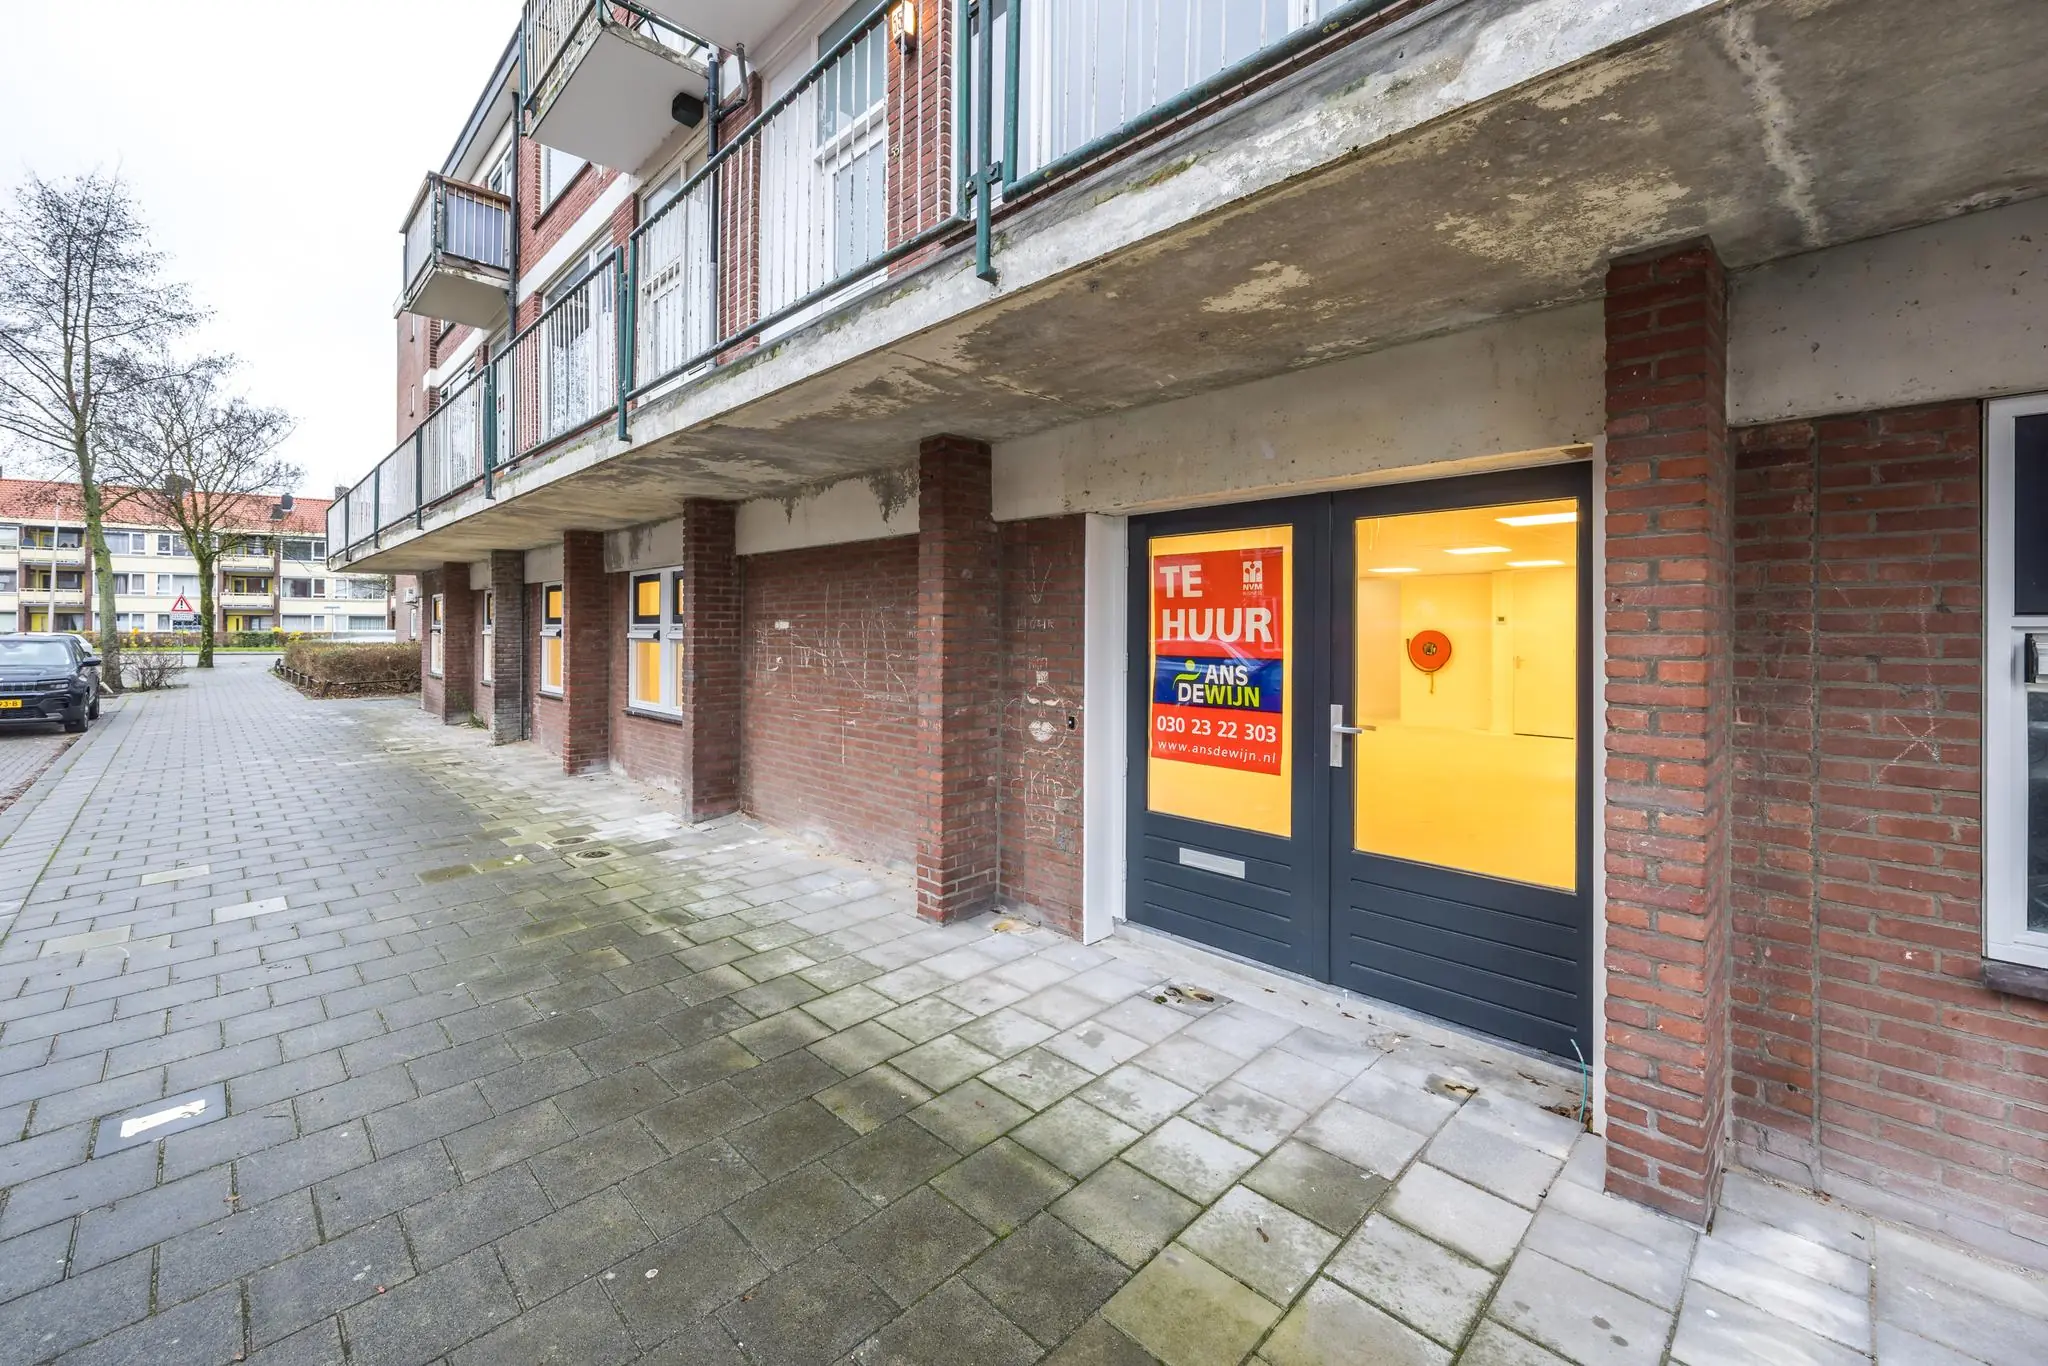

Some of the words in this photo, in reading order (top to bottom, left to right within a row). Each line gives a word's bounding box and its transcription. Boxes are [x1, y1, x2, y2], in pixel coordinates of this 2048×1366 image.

[1159, 564, 1203, 599] TE
[1242, 583, 1263, 591] NVM
[1162, 607, 1273, 643] HUUR
[1204, 664, 1249, 686] ANS
[1177, 682, 1260, 708] DEWIJN
[1156, 715, 1186, 733] 030
[1191, 718, 1211, 736] 23
[1217, 720, 1238, 739] 22
[1244, 723, 1277, 743] 303
[1158, 740, 1276, 764] www.ansdewijn.nl
